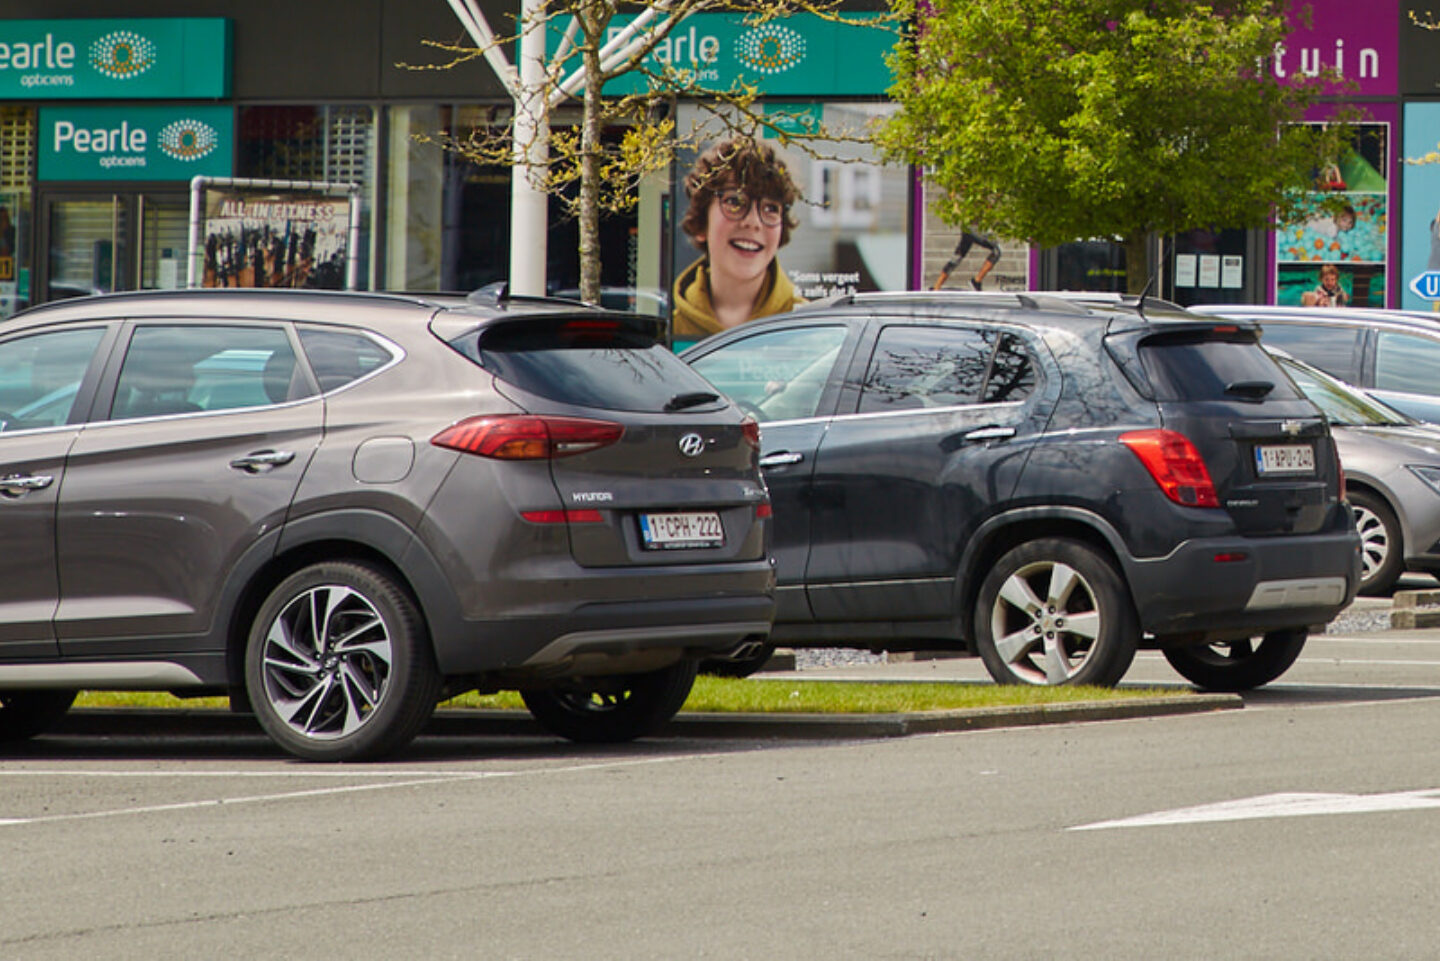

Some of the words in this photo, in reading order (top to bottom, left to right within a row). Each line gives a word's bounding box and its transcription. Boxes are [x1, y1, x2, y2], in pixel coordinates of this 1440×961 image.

[0, 33, 75, 68] earle
[606, 26, 720, 63] arle
[20, 73, 74, 87] opticiens
[54, 120, 147, 152] Pearle
[99, 155, 146, 168] opticiens
[270, 202, 335, 220] FITNESS
[572, 492, 613, 502] HYUNDAI
[650, 515, 721, 538] 1-CPH-222
